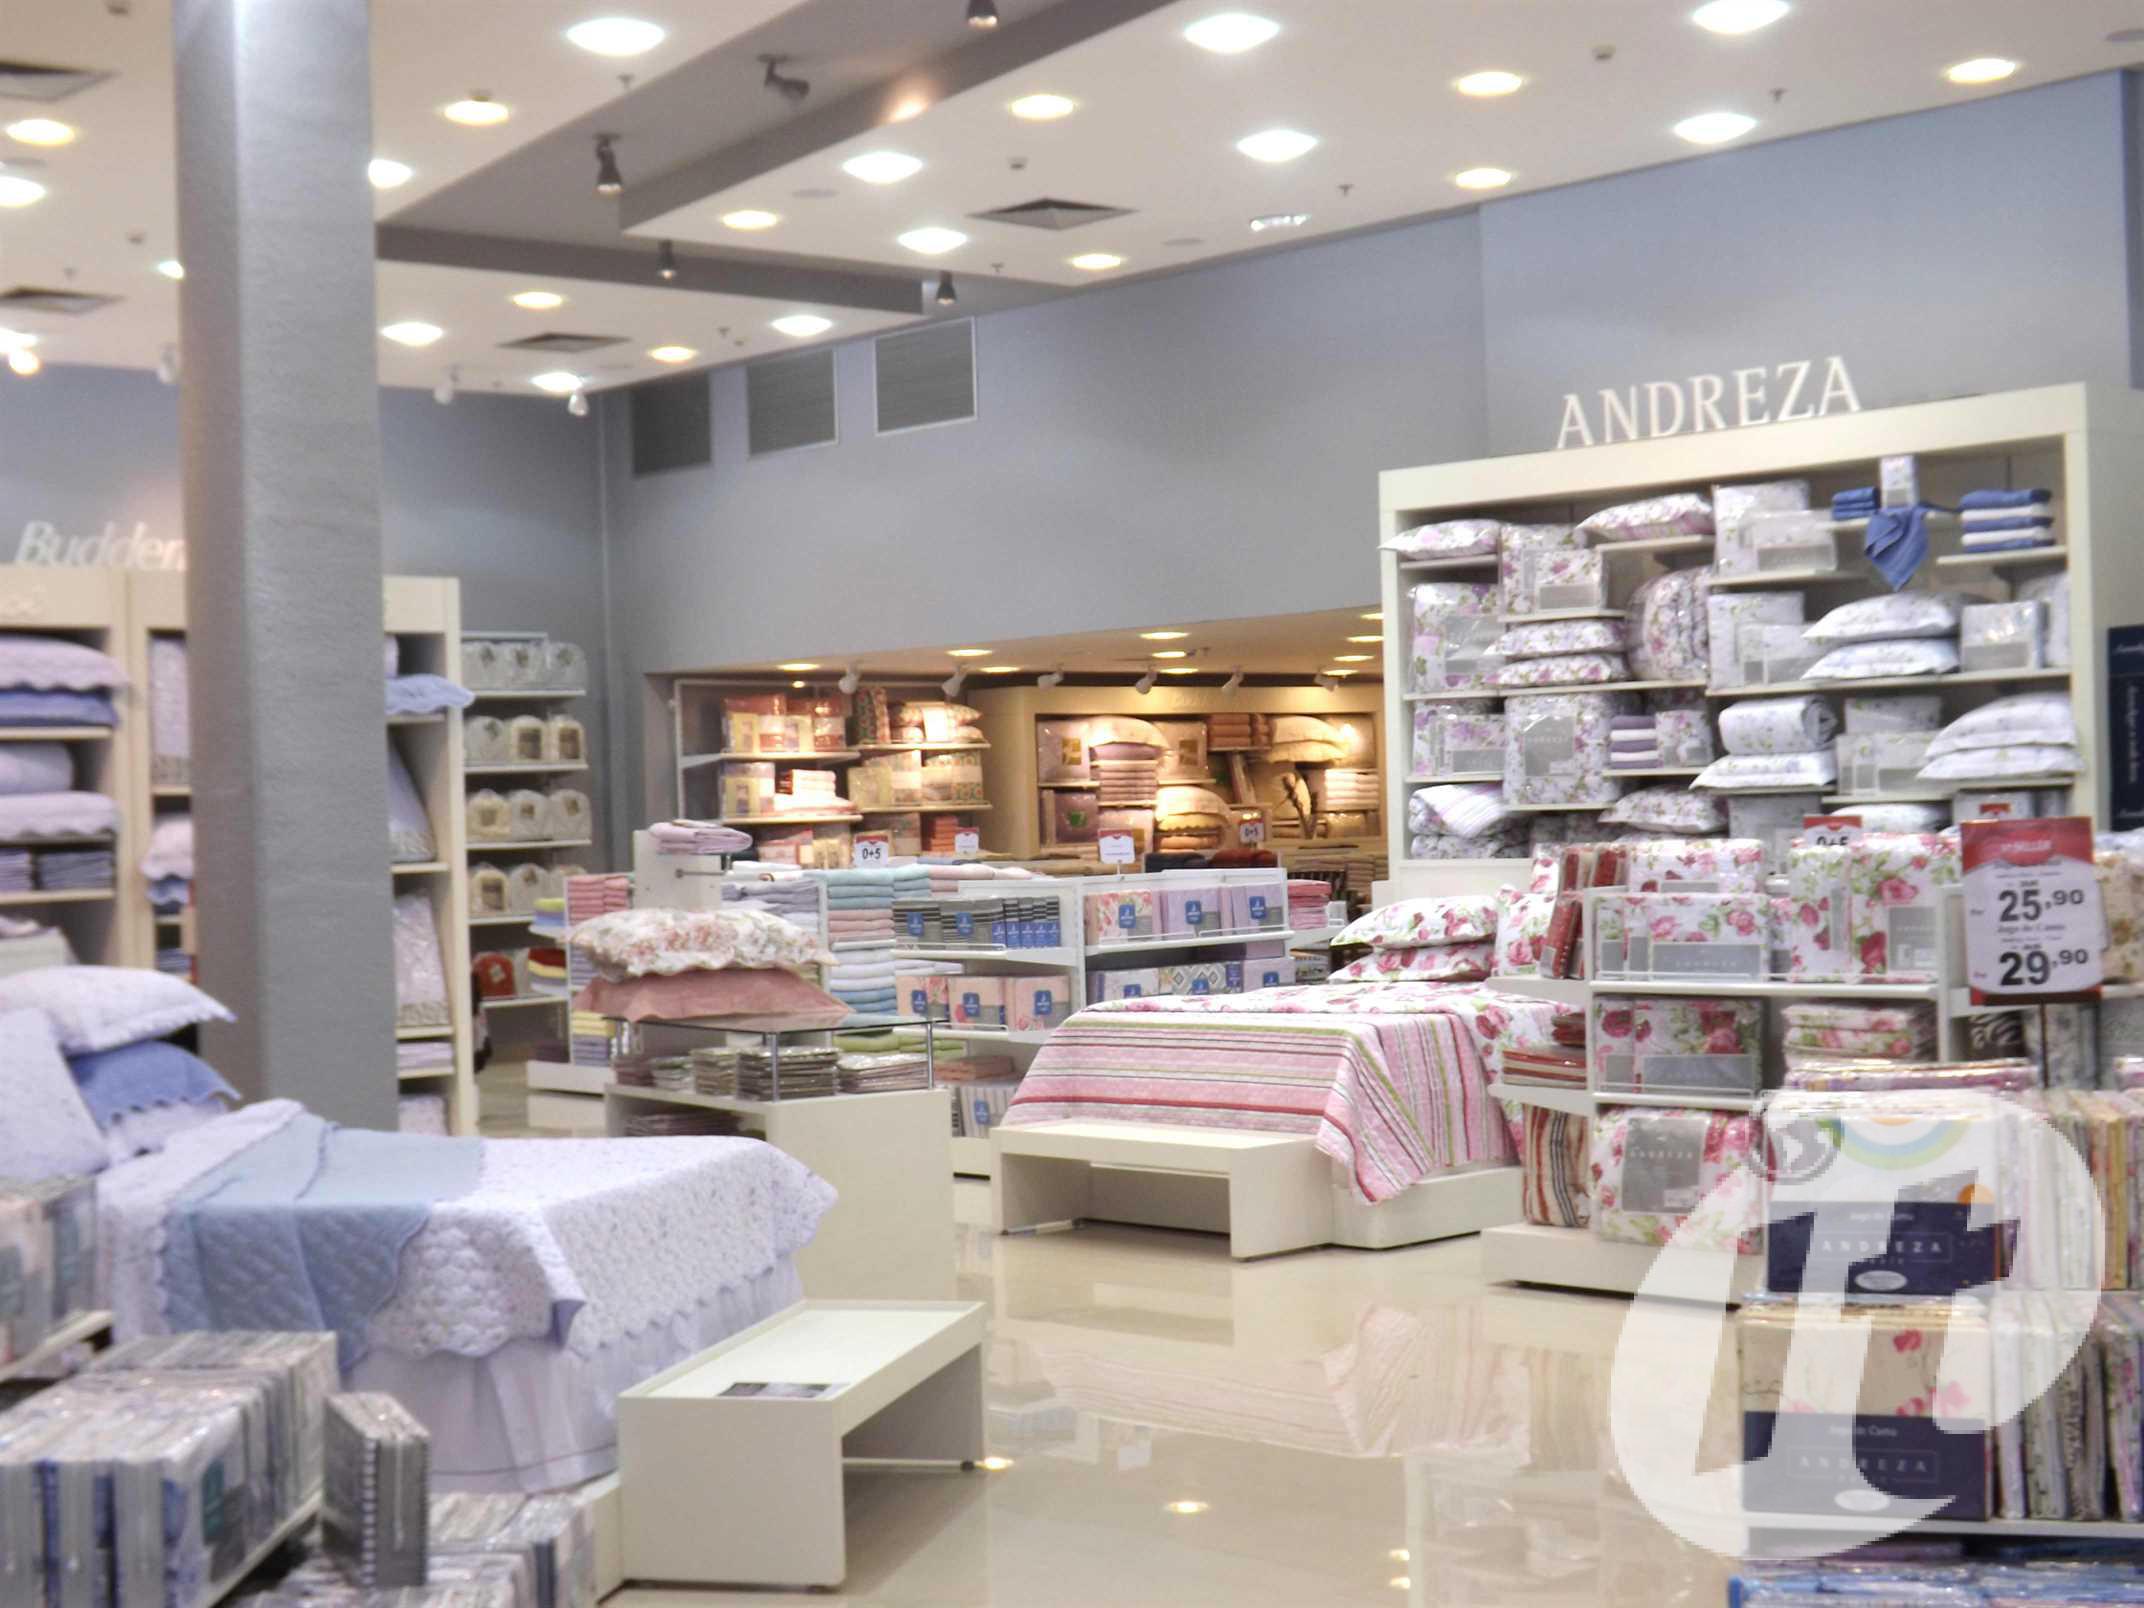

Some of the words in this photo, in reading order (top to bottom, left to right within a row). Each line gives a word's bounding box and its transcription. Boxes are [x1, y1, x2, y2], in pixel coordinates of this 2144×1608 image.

[1556, 355, 1862, 450] ANDREZA
[1999, 888, 2085, 922] 25,90
[1999, 948, 2089, 987] 29,90
[1823, 1239, 1943, 1252] ANDREZA
[1800, 1455, 1928, 1472] ANDREZA
